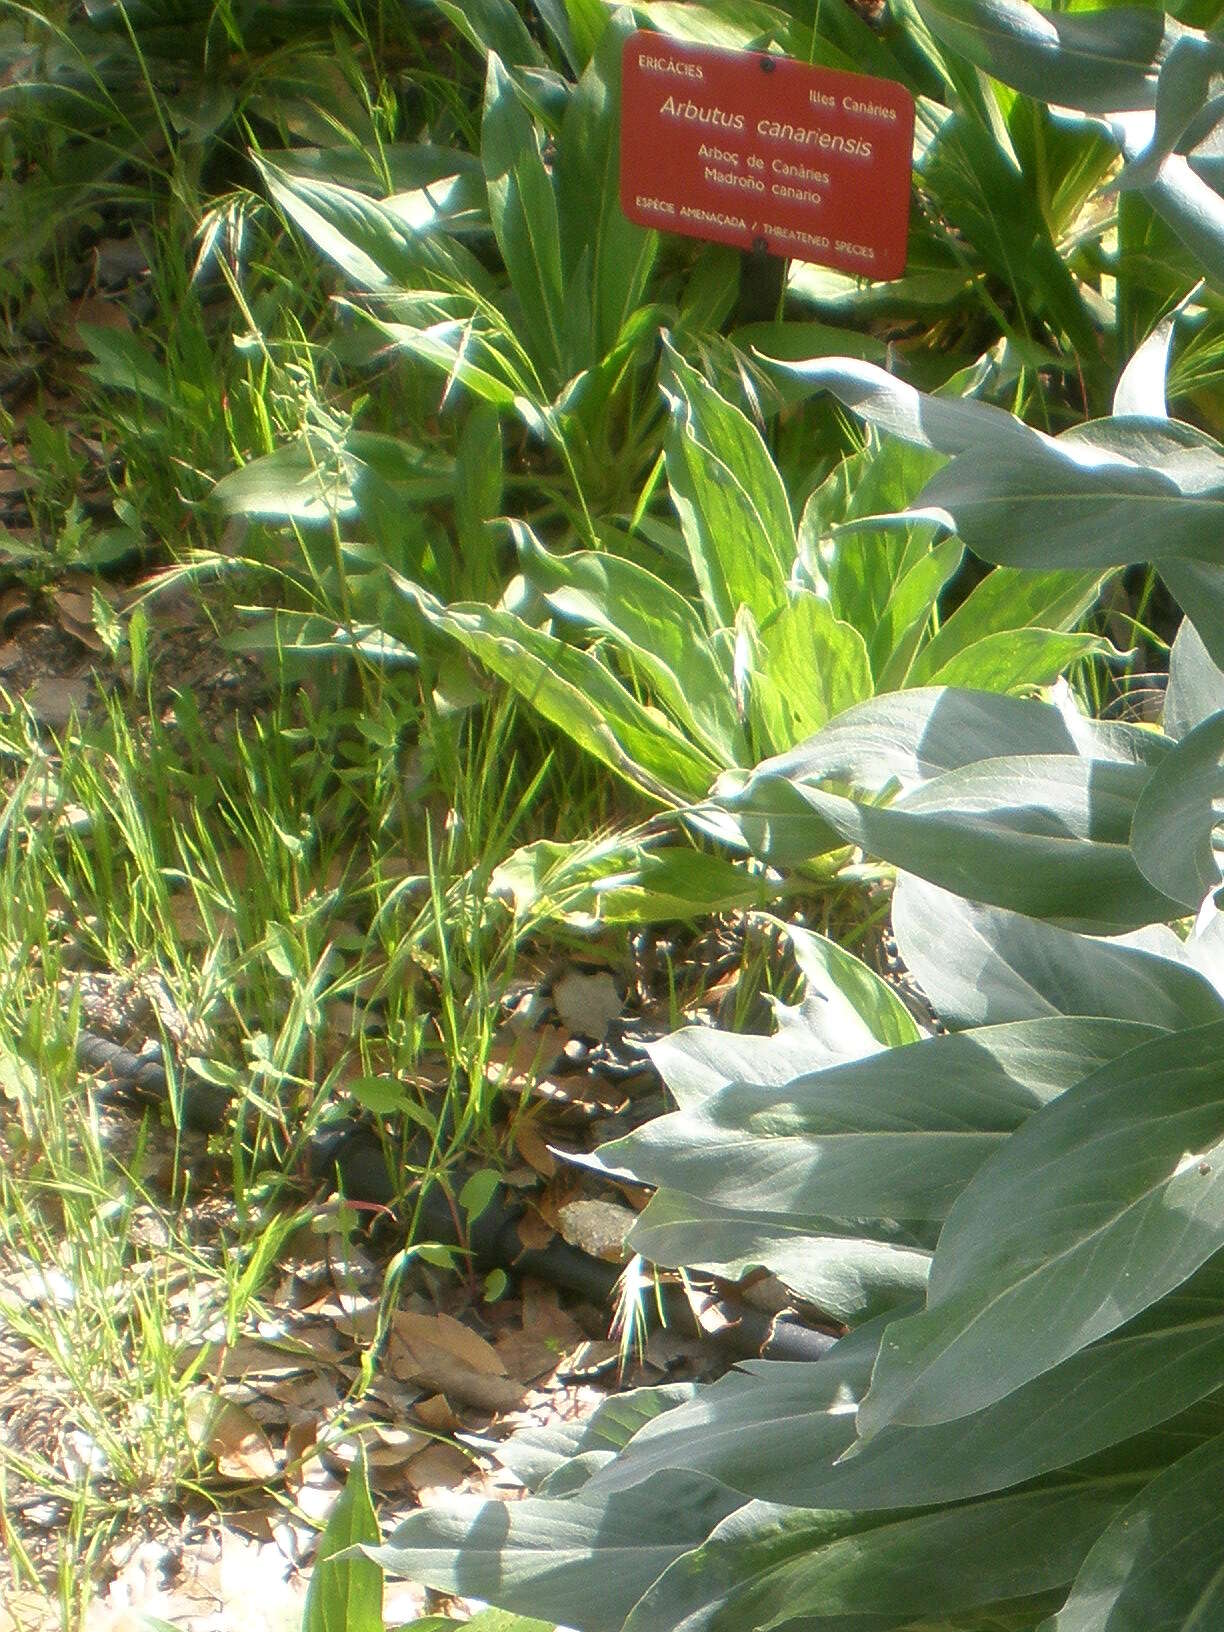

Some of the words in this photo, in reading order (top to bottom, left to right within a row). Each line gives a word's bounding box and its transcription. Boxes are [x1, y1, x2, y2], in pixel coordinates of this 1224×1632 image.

[809, 90, 835, 108] Illes
[660, 96, 745, 130] Arbutus
[757, 119, 872, 157] canariensis
[698, 144, 739, 166] Arboç
[747, 154, 764, 171] de
[704, 167, 765, 192] Madroño
[772, 184, 822, 204] canario
[680, 207, 746, 230] AMENAÇADA
[763, 223, 830, 248] THREATENED
[835, 240, 875, 258] SPECIES
